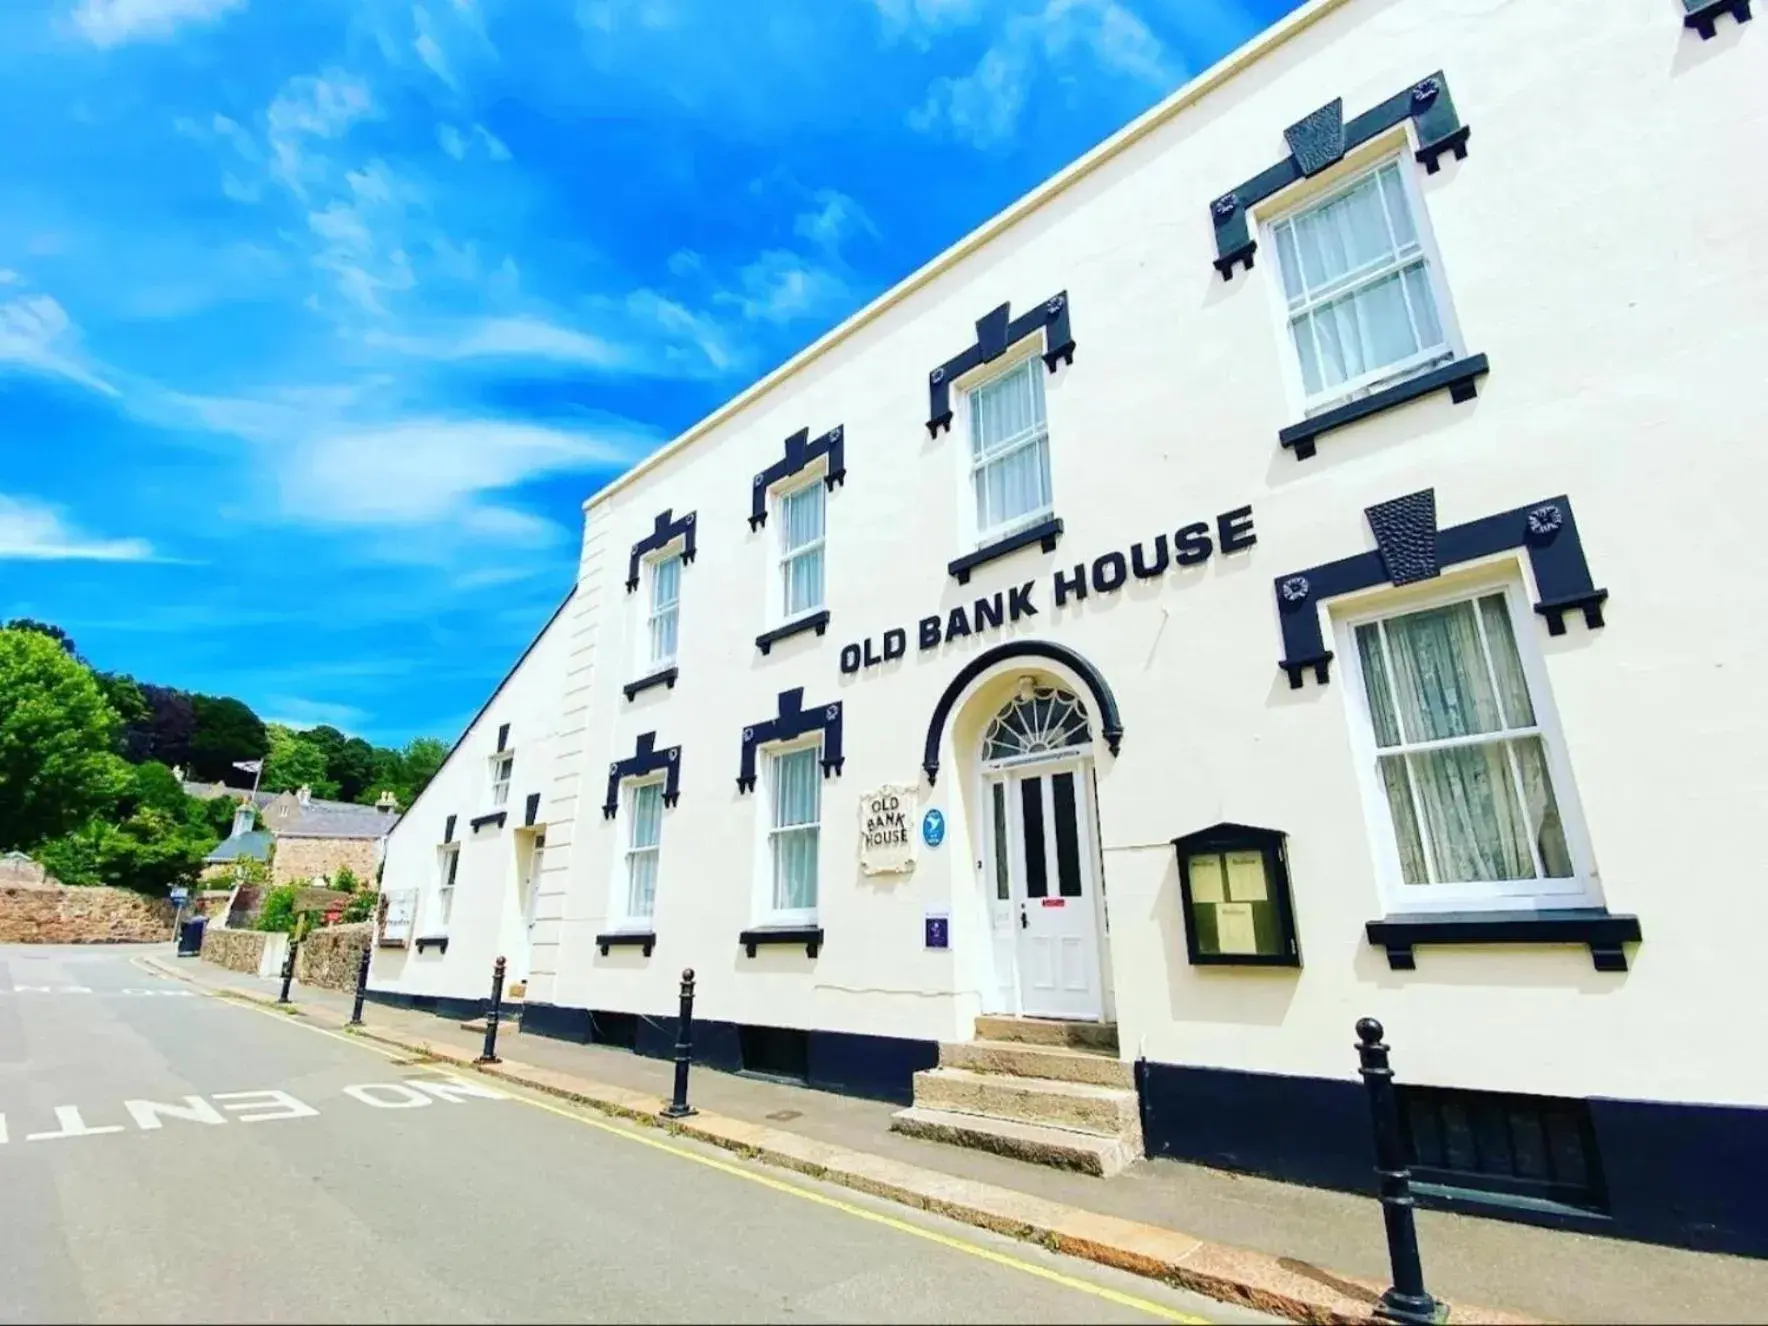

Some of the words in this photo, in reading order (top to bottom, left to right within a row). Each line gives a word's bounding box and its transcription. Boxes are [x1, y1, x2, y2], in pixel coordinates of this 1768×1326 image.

[840, 627, 906, 674] OLD
[919, 580, 1038, 650] BANK
[1054, 504, 1257, 607] HOUSE
[871, 796, 899, 813] OLD
[867, 812, 905, 832] BANK
[864, 829, 908, 847] HOUSE
[0, 1089, 321, 1144] ENT
